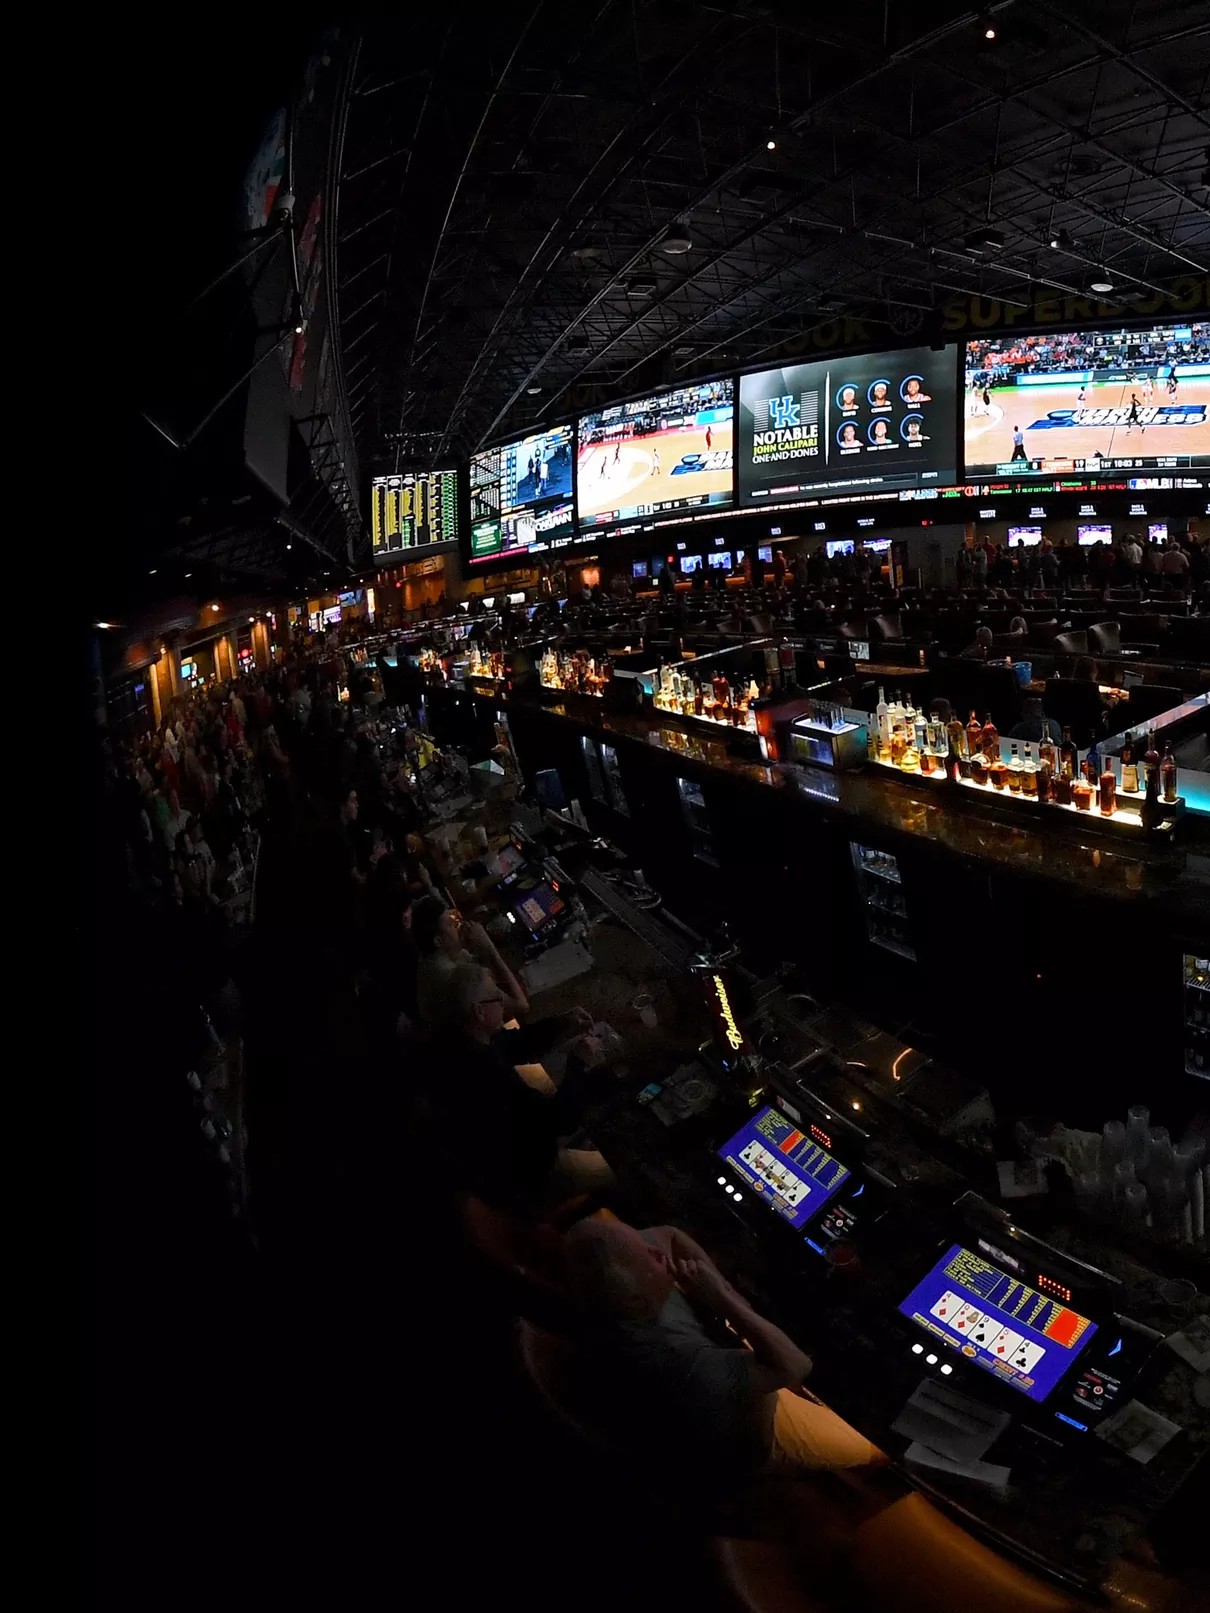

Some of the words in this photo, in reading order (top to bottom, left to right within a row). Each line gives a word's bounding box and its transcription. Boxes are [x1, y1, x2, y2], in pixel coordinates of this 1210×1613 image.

[753, 425, 818, 447] NOTABLE
[753, 442, 778, 456] JOHN
[778, 437, 818, 452] CALIPARI
[713, 974, 743, 1050] Budweiser
